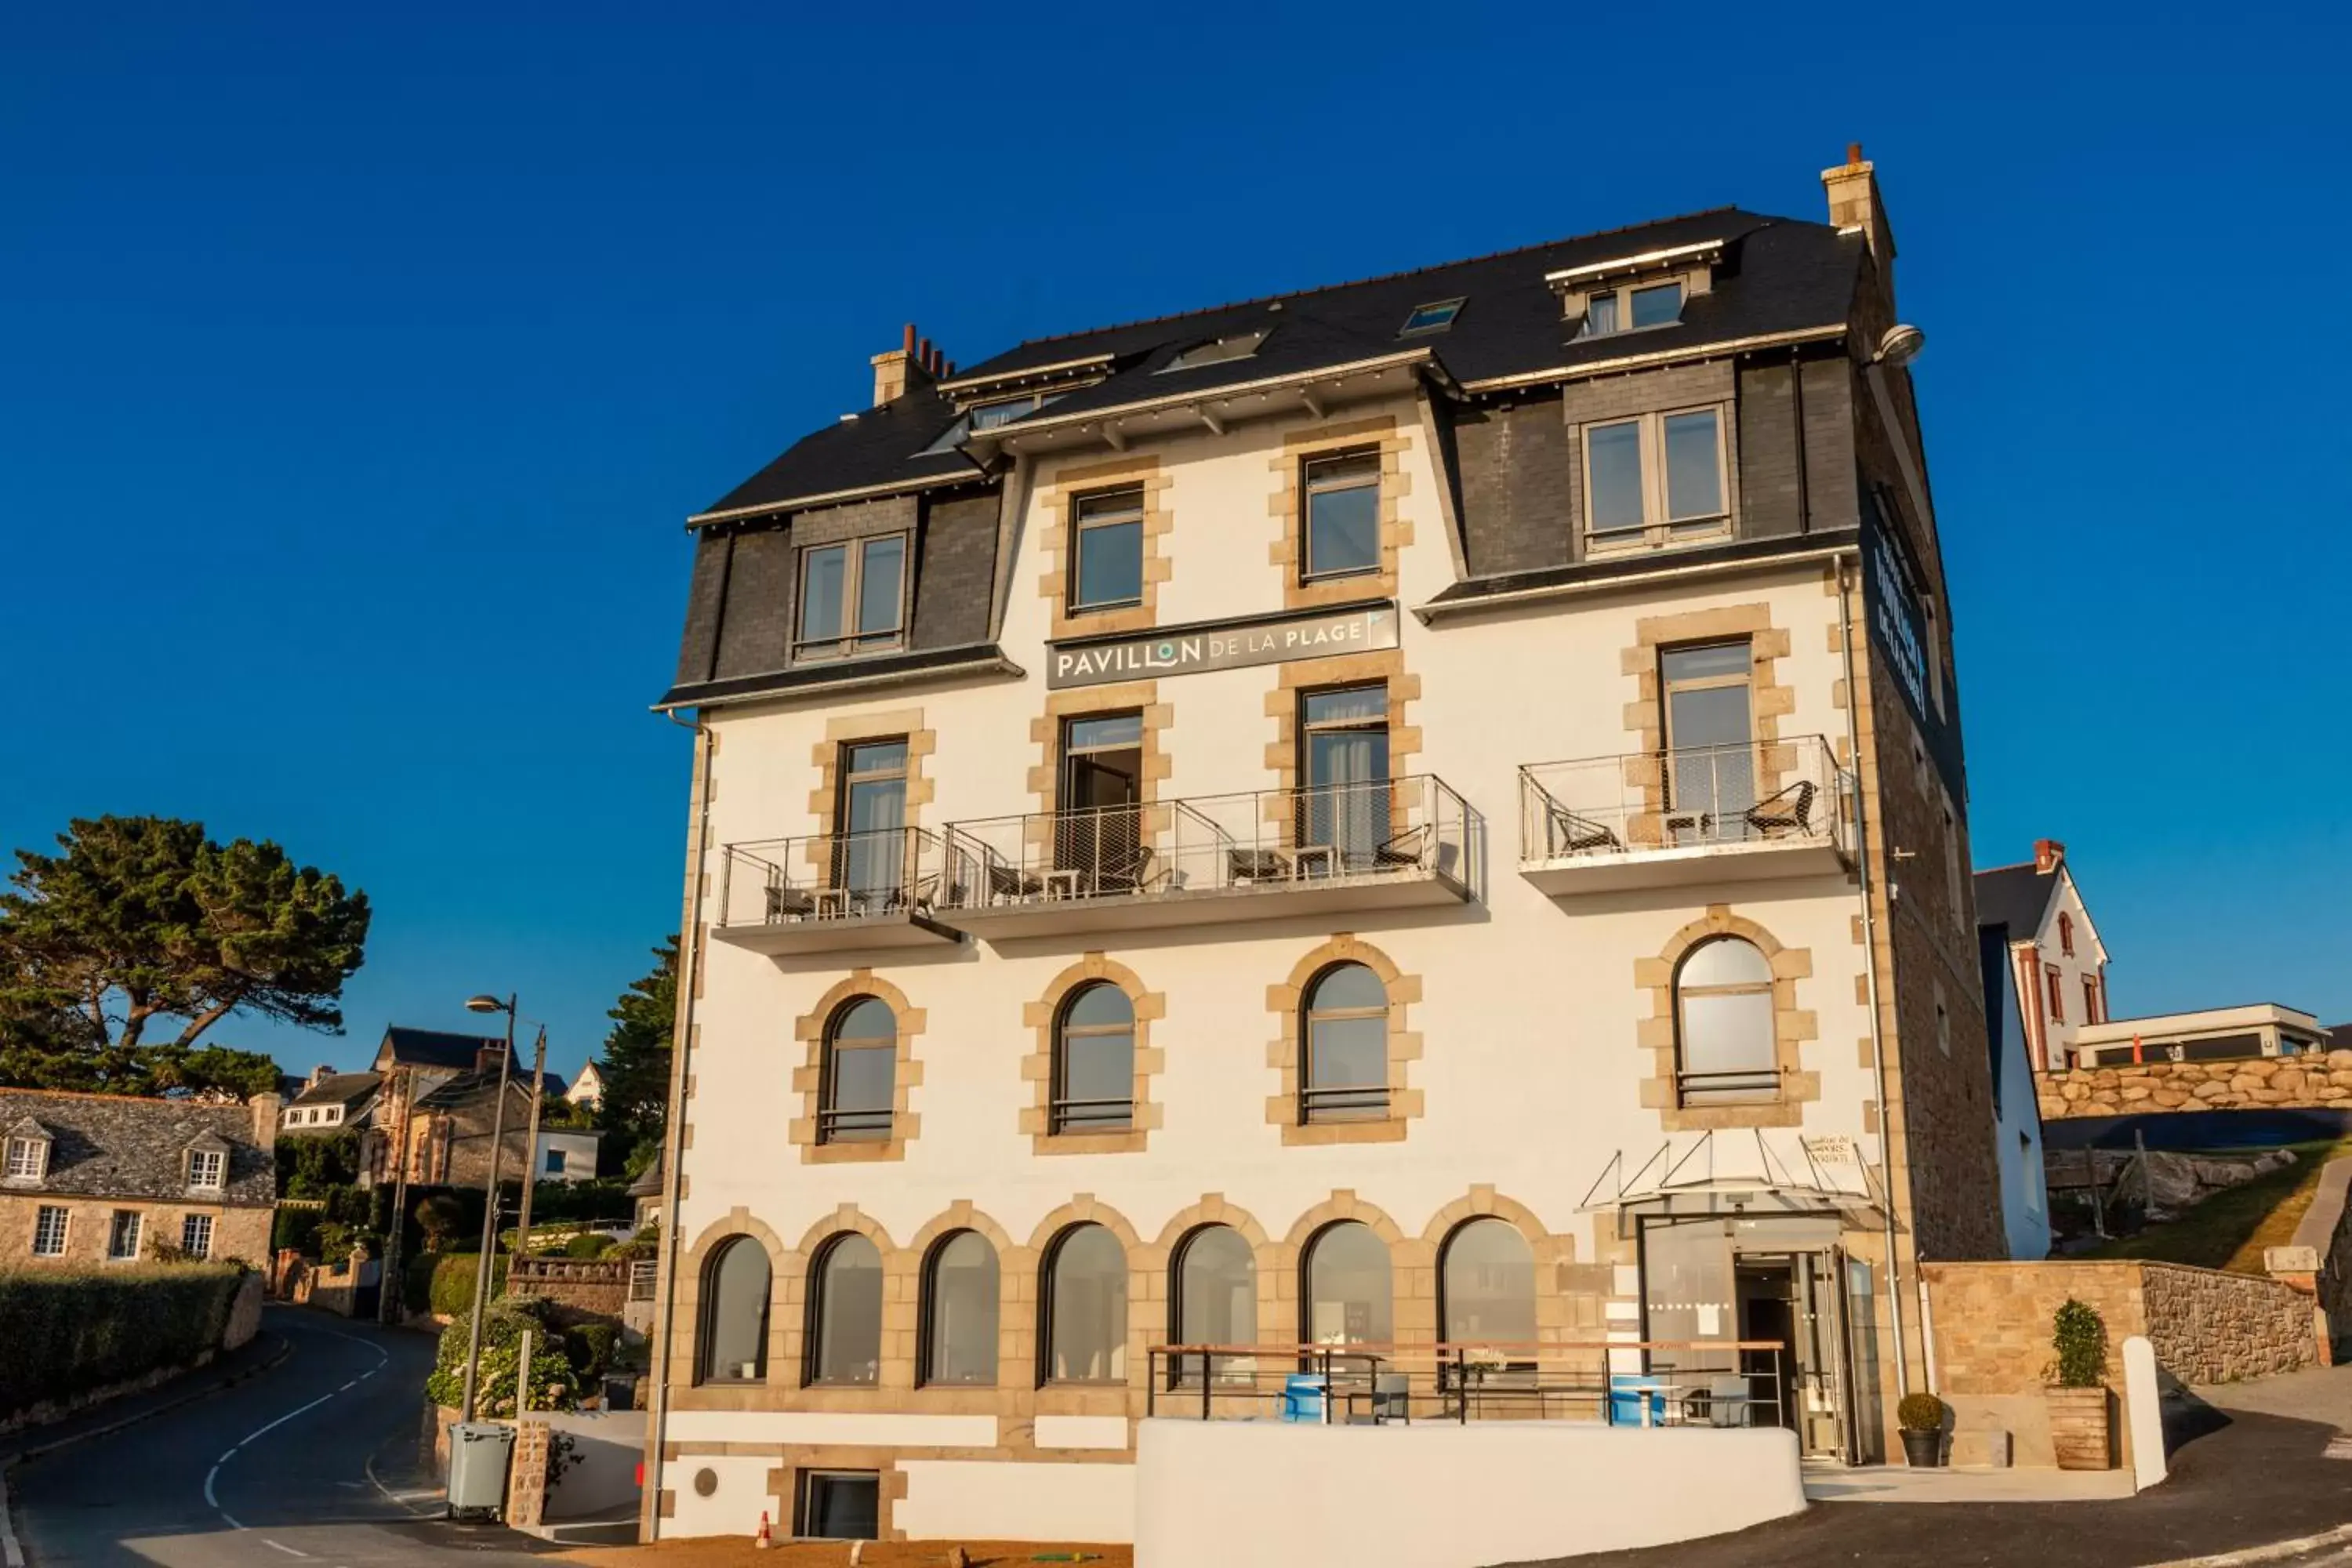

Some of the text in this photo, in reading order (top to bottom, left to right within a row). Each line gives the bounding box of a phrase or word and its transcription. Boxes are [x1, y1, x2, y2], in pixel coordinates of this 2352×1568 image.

[1058, 622, 1362, 677] PAVILLON DE LA PLAGE
